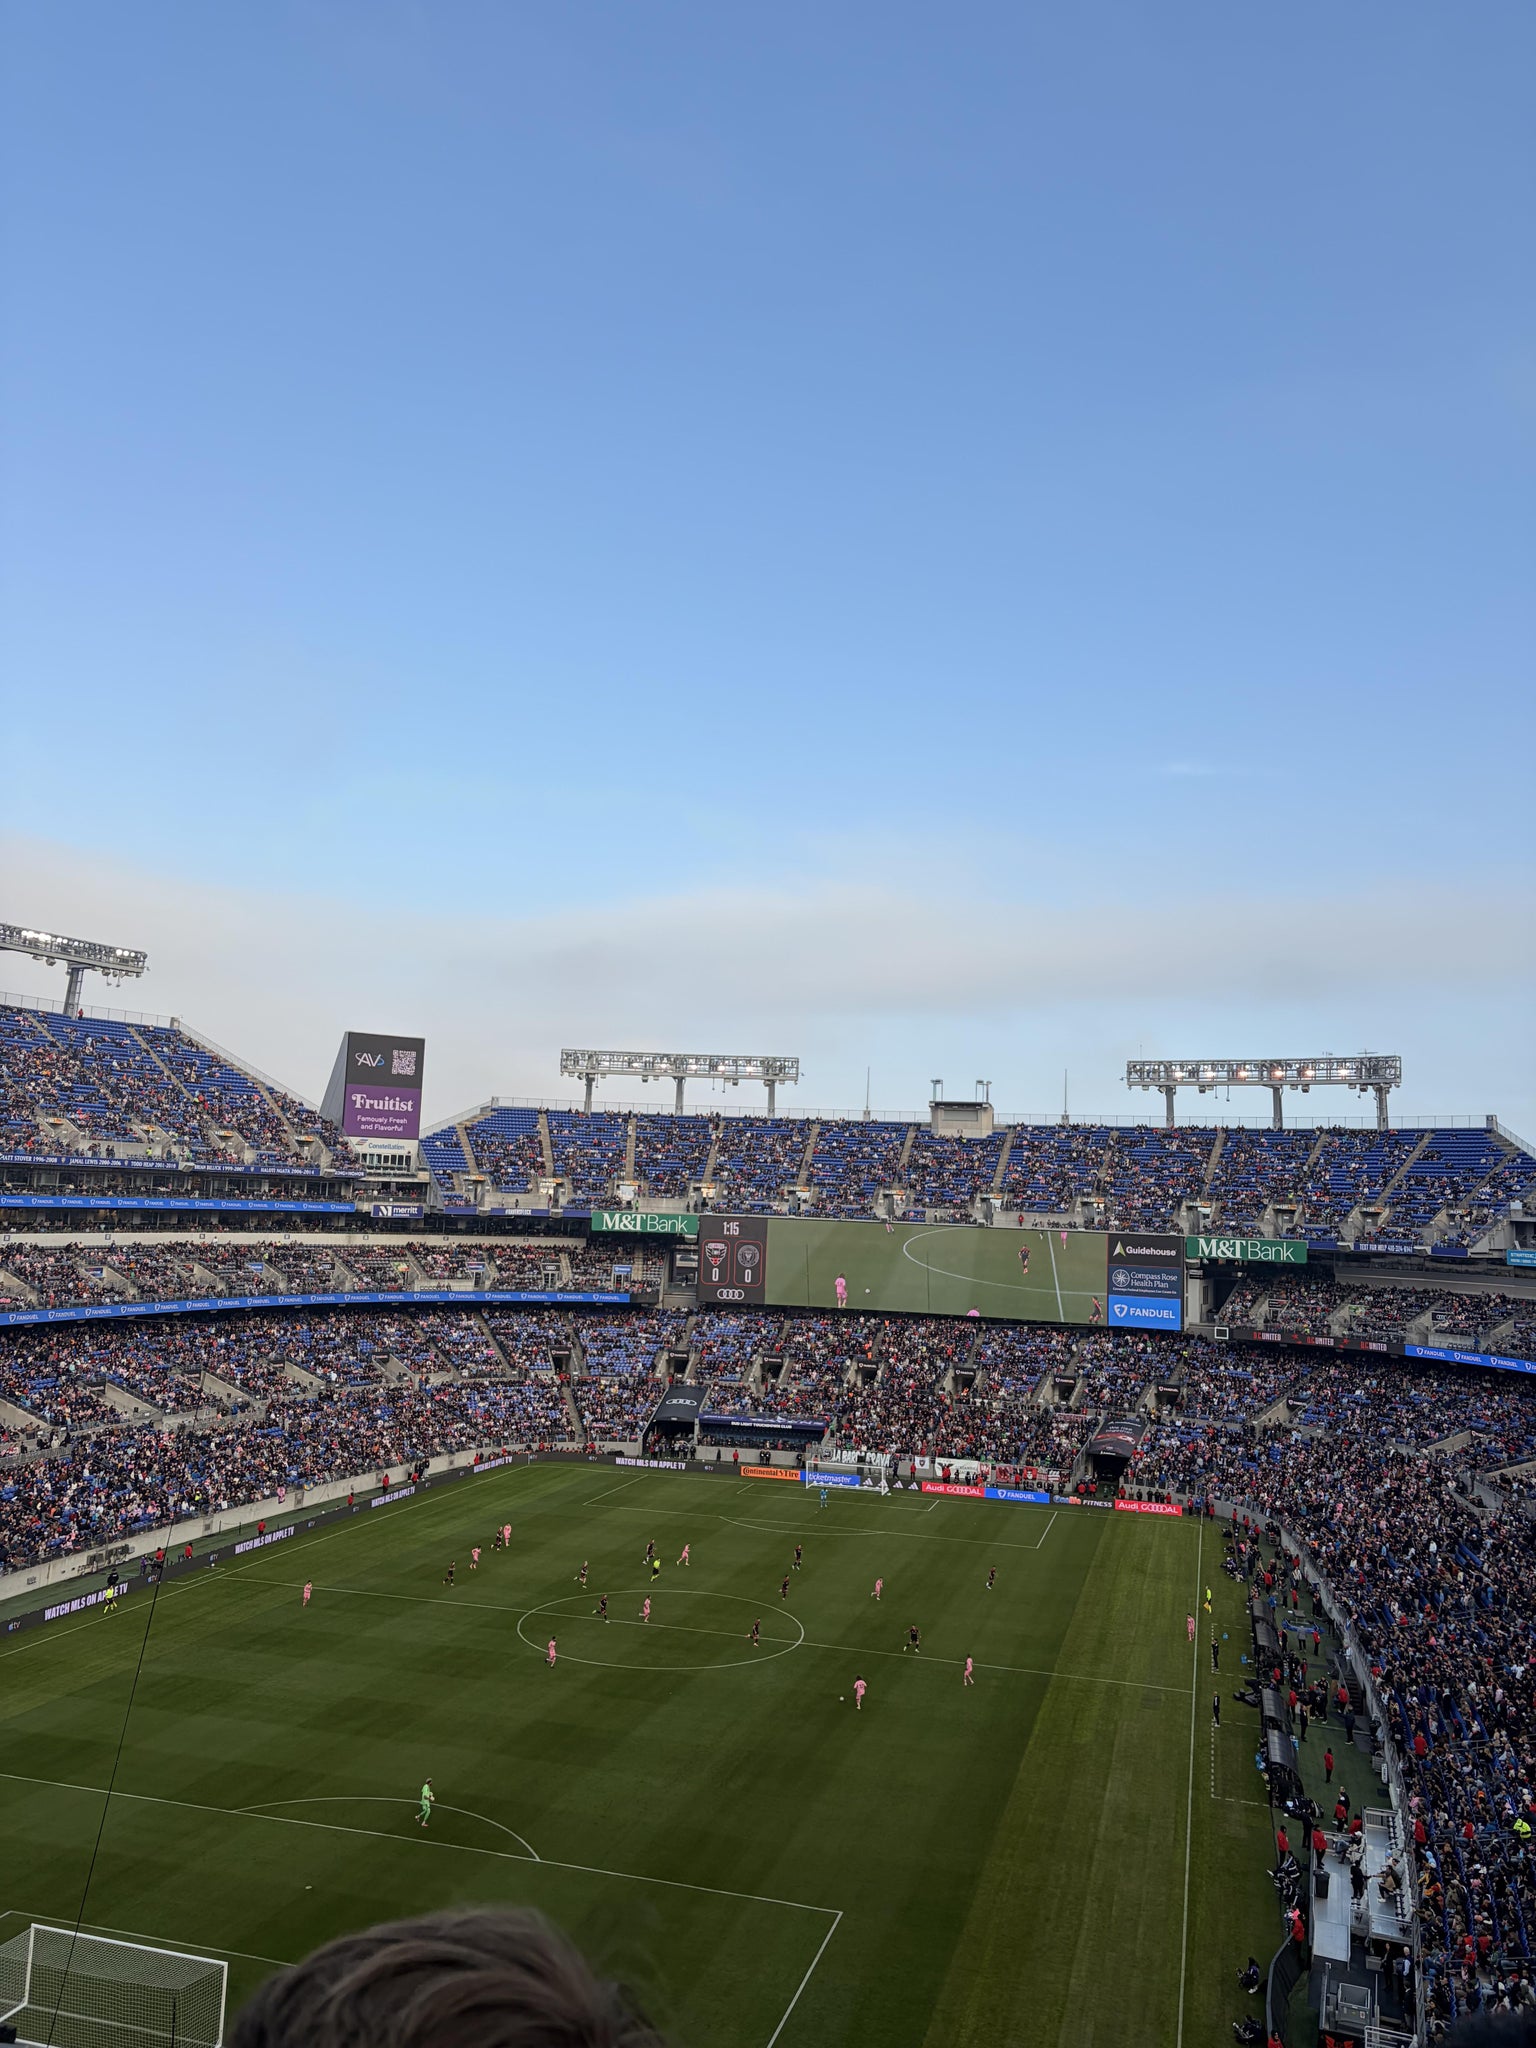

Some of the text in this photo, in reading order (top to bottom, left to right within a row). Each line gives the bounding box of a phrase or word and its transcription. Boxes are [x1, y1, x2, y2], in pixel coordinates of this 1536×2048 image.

[352, 1094, 414, 1112] Fruitist
[357, 1115, 388, 1124] Famously
[602, 1213, 687, 1232] M&T Bank
[723, 1222, 740, 1235] 1:15
[1126, 1246, 1176, 1256] Guidehouse
[1197, 1239, 1295, 1261] M&T Bank
[712, 1268, 719, 1281] 0
[745, 1269, 751, 1283] 0
[1130, 1272, 1160, 1280] Compass
[1130, 1308, 1175, 1319] FANDUEL
[1262, 1332, 1281, 1341] UNITED
[1315, 1337, 1334, 1346] UNITED
[616, 1457, 636, 1466] WATCH
[659, 1460, 677, 1469] APPLE
[743, 1466, 778, 1476] Continental
[809, 1472, 852, 1484] ticketmaster
[409, 1486, 416, 1494] TV
[1083, 1499, 1112, 1508] FITNESS
[235, 1526, 295, 1555] WATCH MLS ON APPLE TV
[45, 1602, 70, 1621] WATCH
[71, 1597, 86, 1612] MLS
[86, 1594, 97, 1607] ON
[118, 1582, 128, 1594] TV
